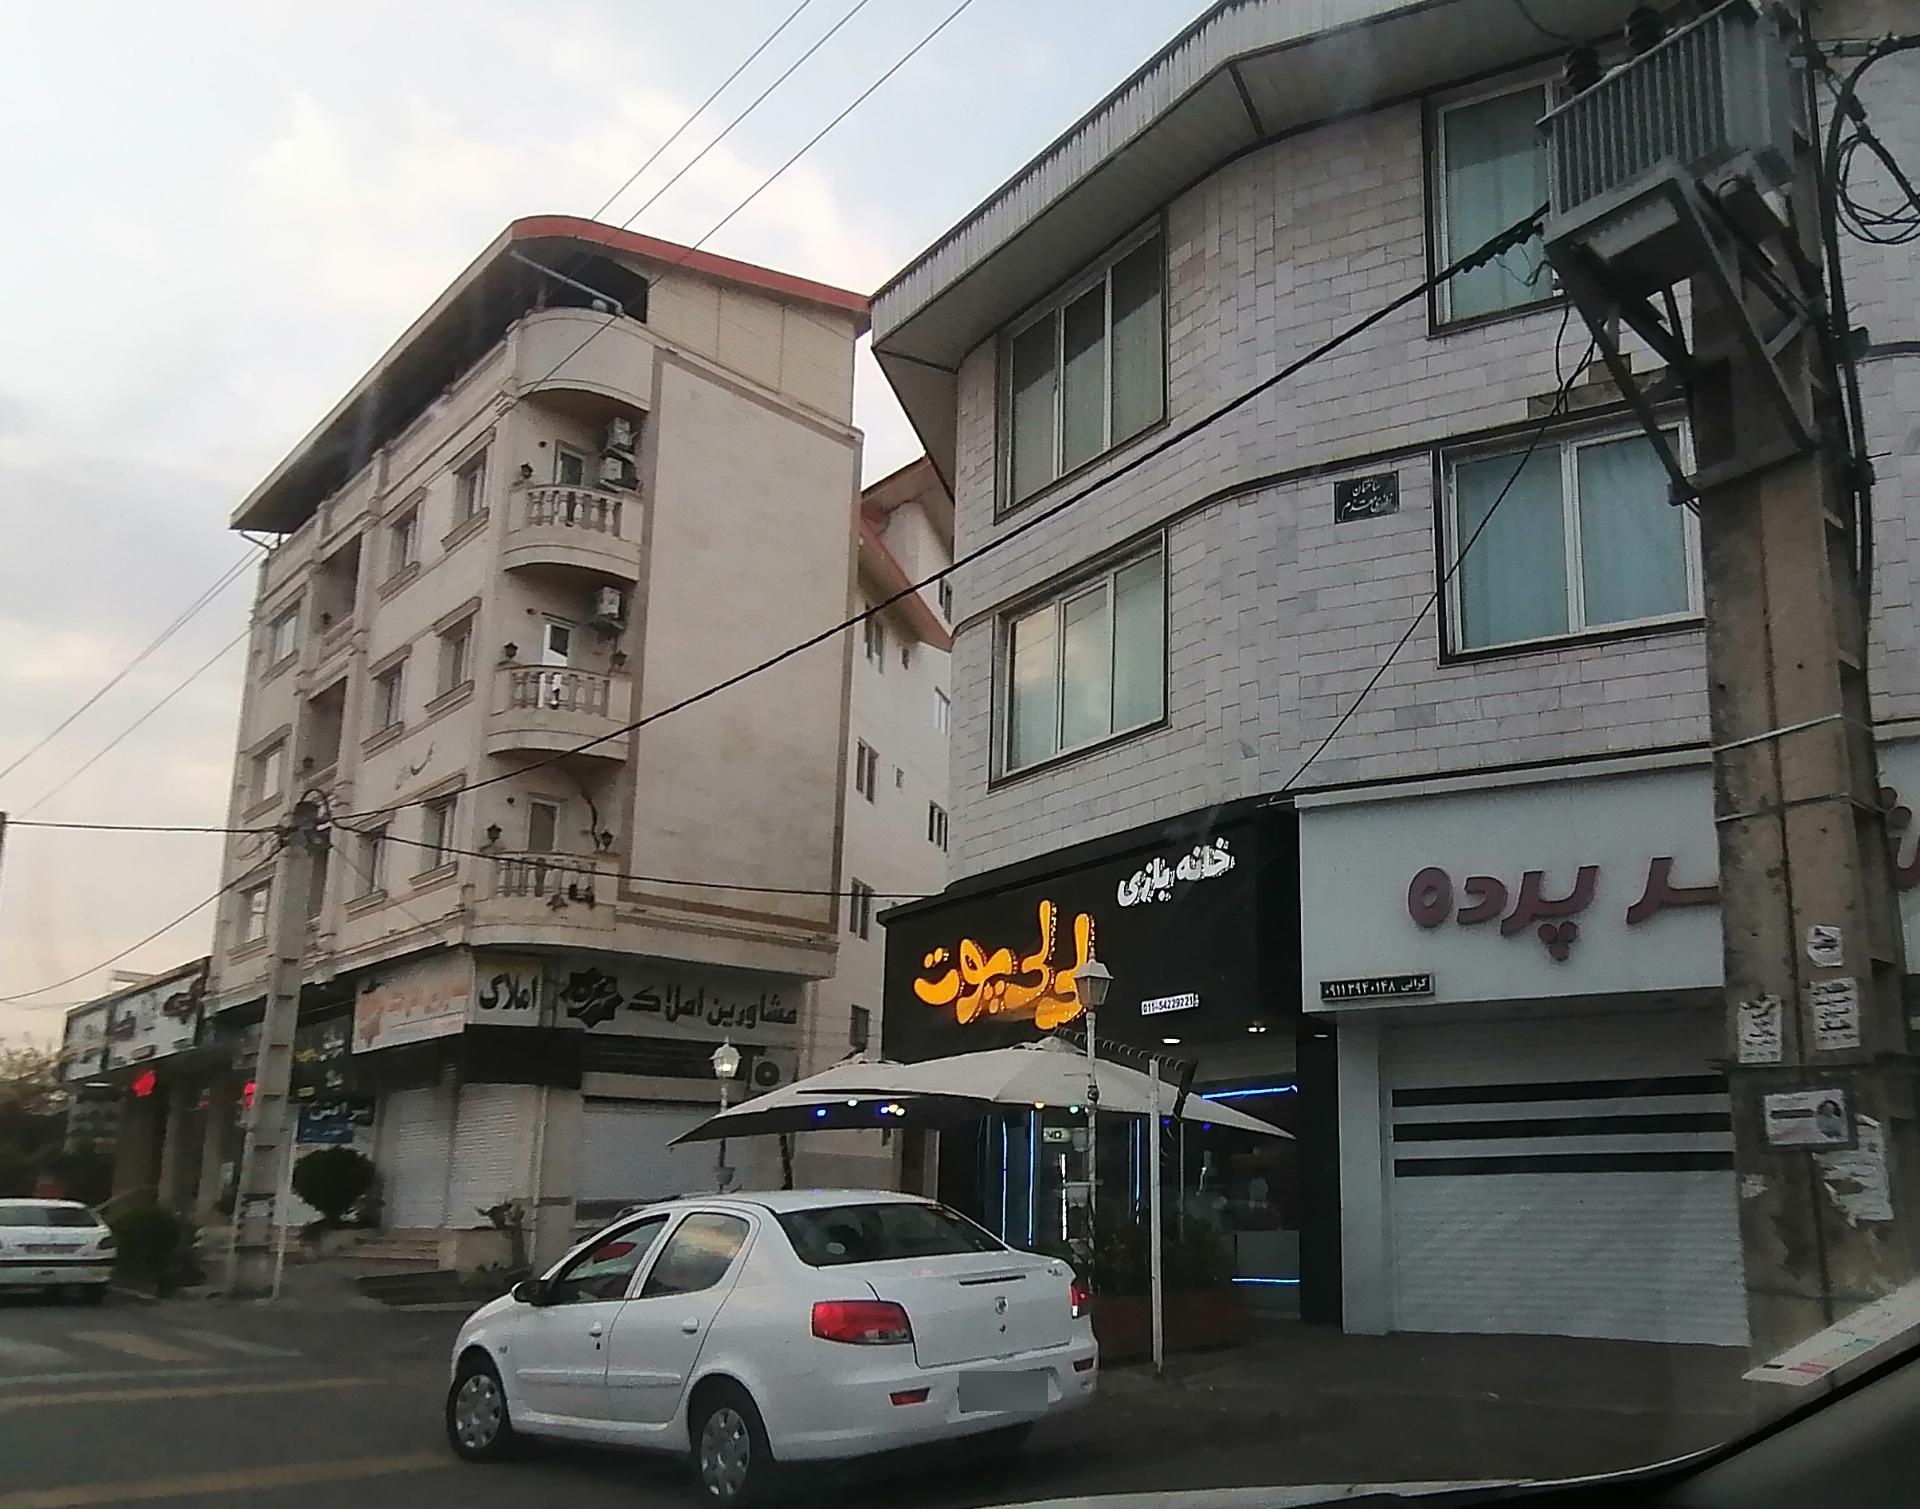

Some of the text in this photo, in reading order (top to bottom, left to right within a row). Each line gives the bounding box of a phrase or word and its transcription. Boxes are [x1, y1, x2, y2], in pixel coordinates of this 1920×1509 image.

[1117, 837, 1230, 907] خانه بازی
[1407, 866, 1599, 961] پرده
[626, 982, 704, 1023] املاک
[706, 992, 798, 1030] مشاورین
